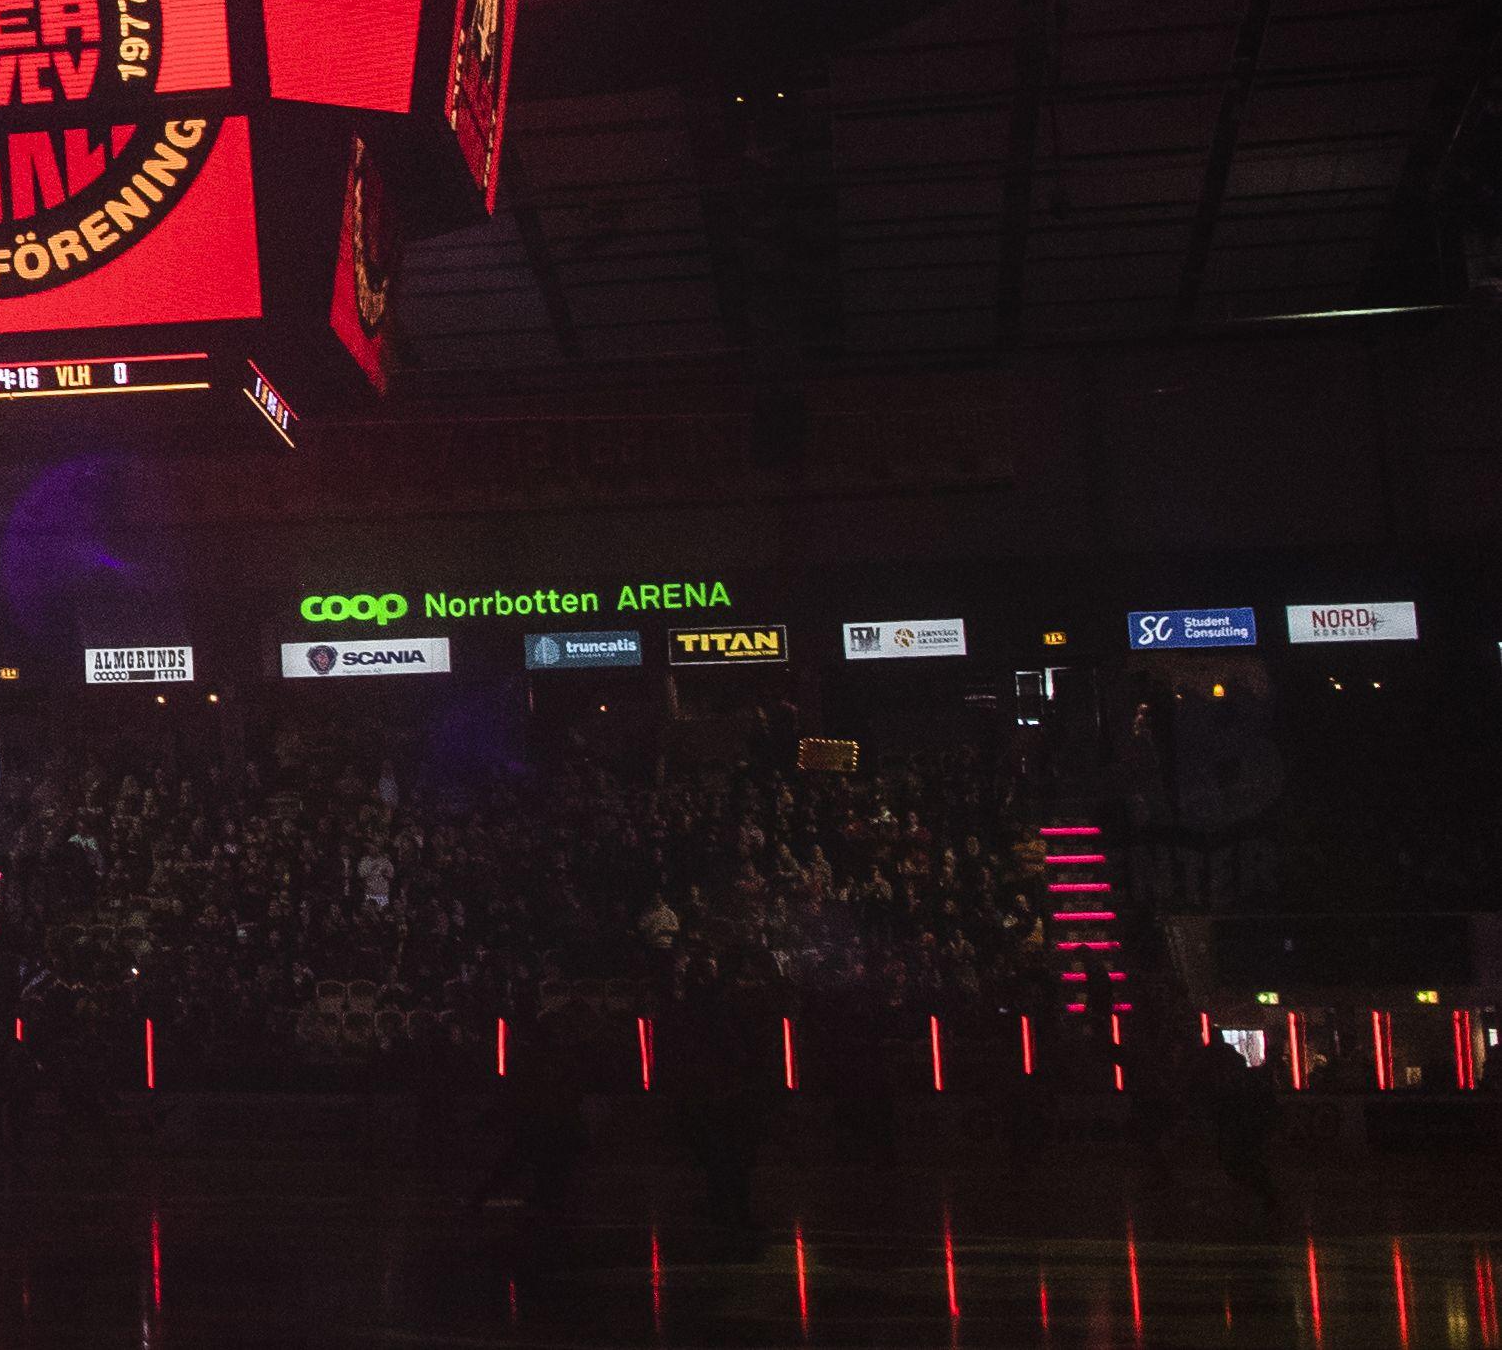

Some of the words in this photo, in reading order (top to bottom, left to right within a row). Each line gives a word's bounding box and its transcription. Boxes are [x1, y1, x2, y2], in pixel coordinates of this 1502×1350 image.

[56, 365, 92, 387] VLH
[113, 362, 128, 385] 0
[299, 593, 408, 626] coop
[424, 590, 598, 619] Norrbotten
[617, 581, 732, 611] ARENA
[1184, 616, 1230, 628] Student
[1311, 609, 1369, 629] NORD
[676, 631, 779, 653] TITAN
[1185, 626, 1249, 639] Consulting
[565, 637, 637, 654] truncatis
[94, 648, 187, 670] ALMGRUNDS
[342, 649, 425, 666] SCANIA
